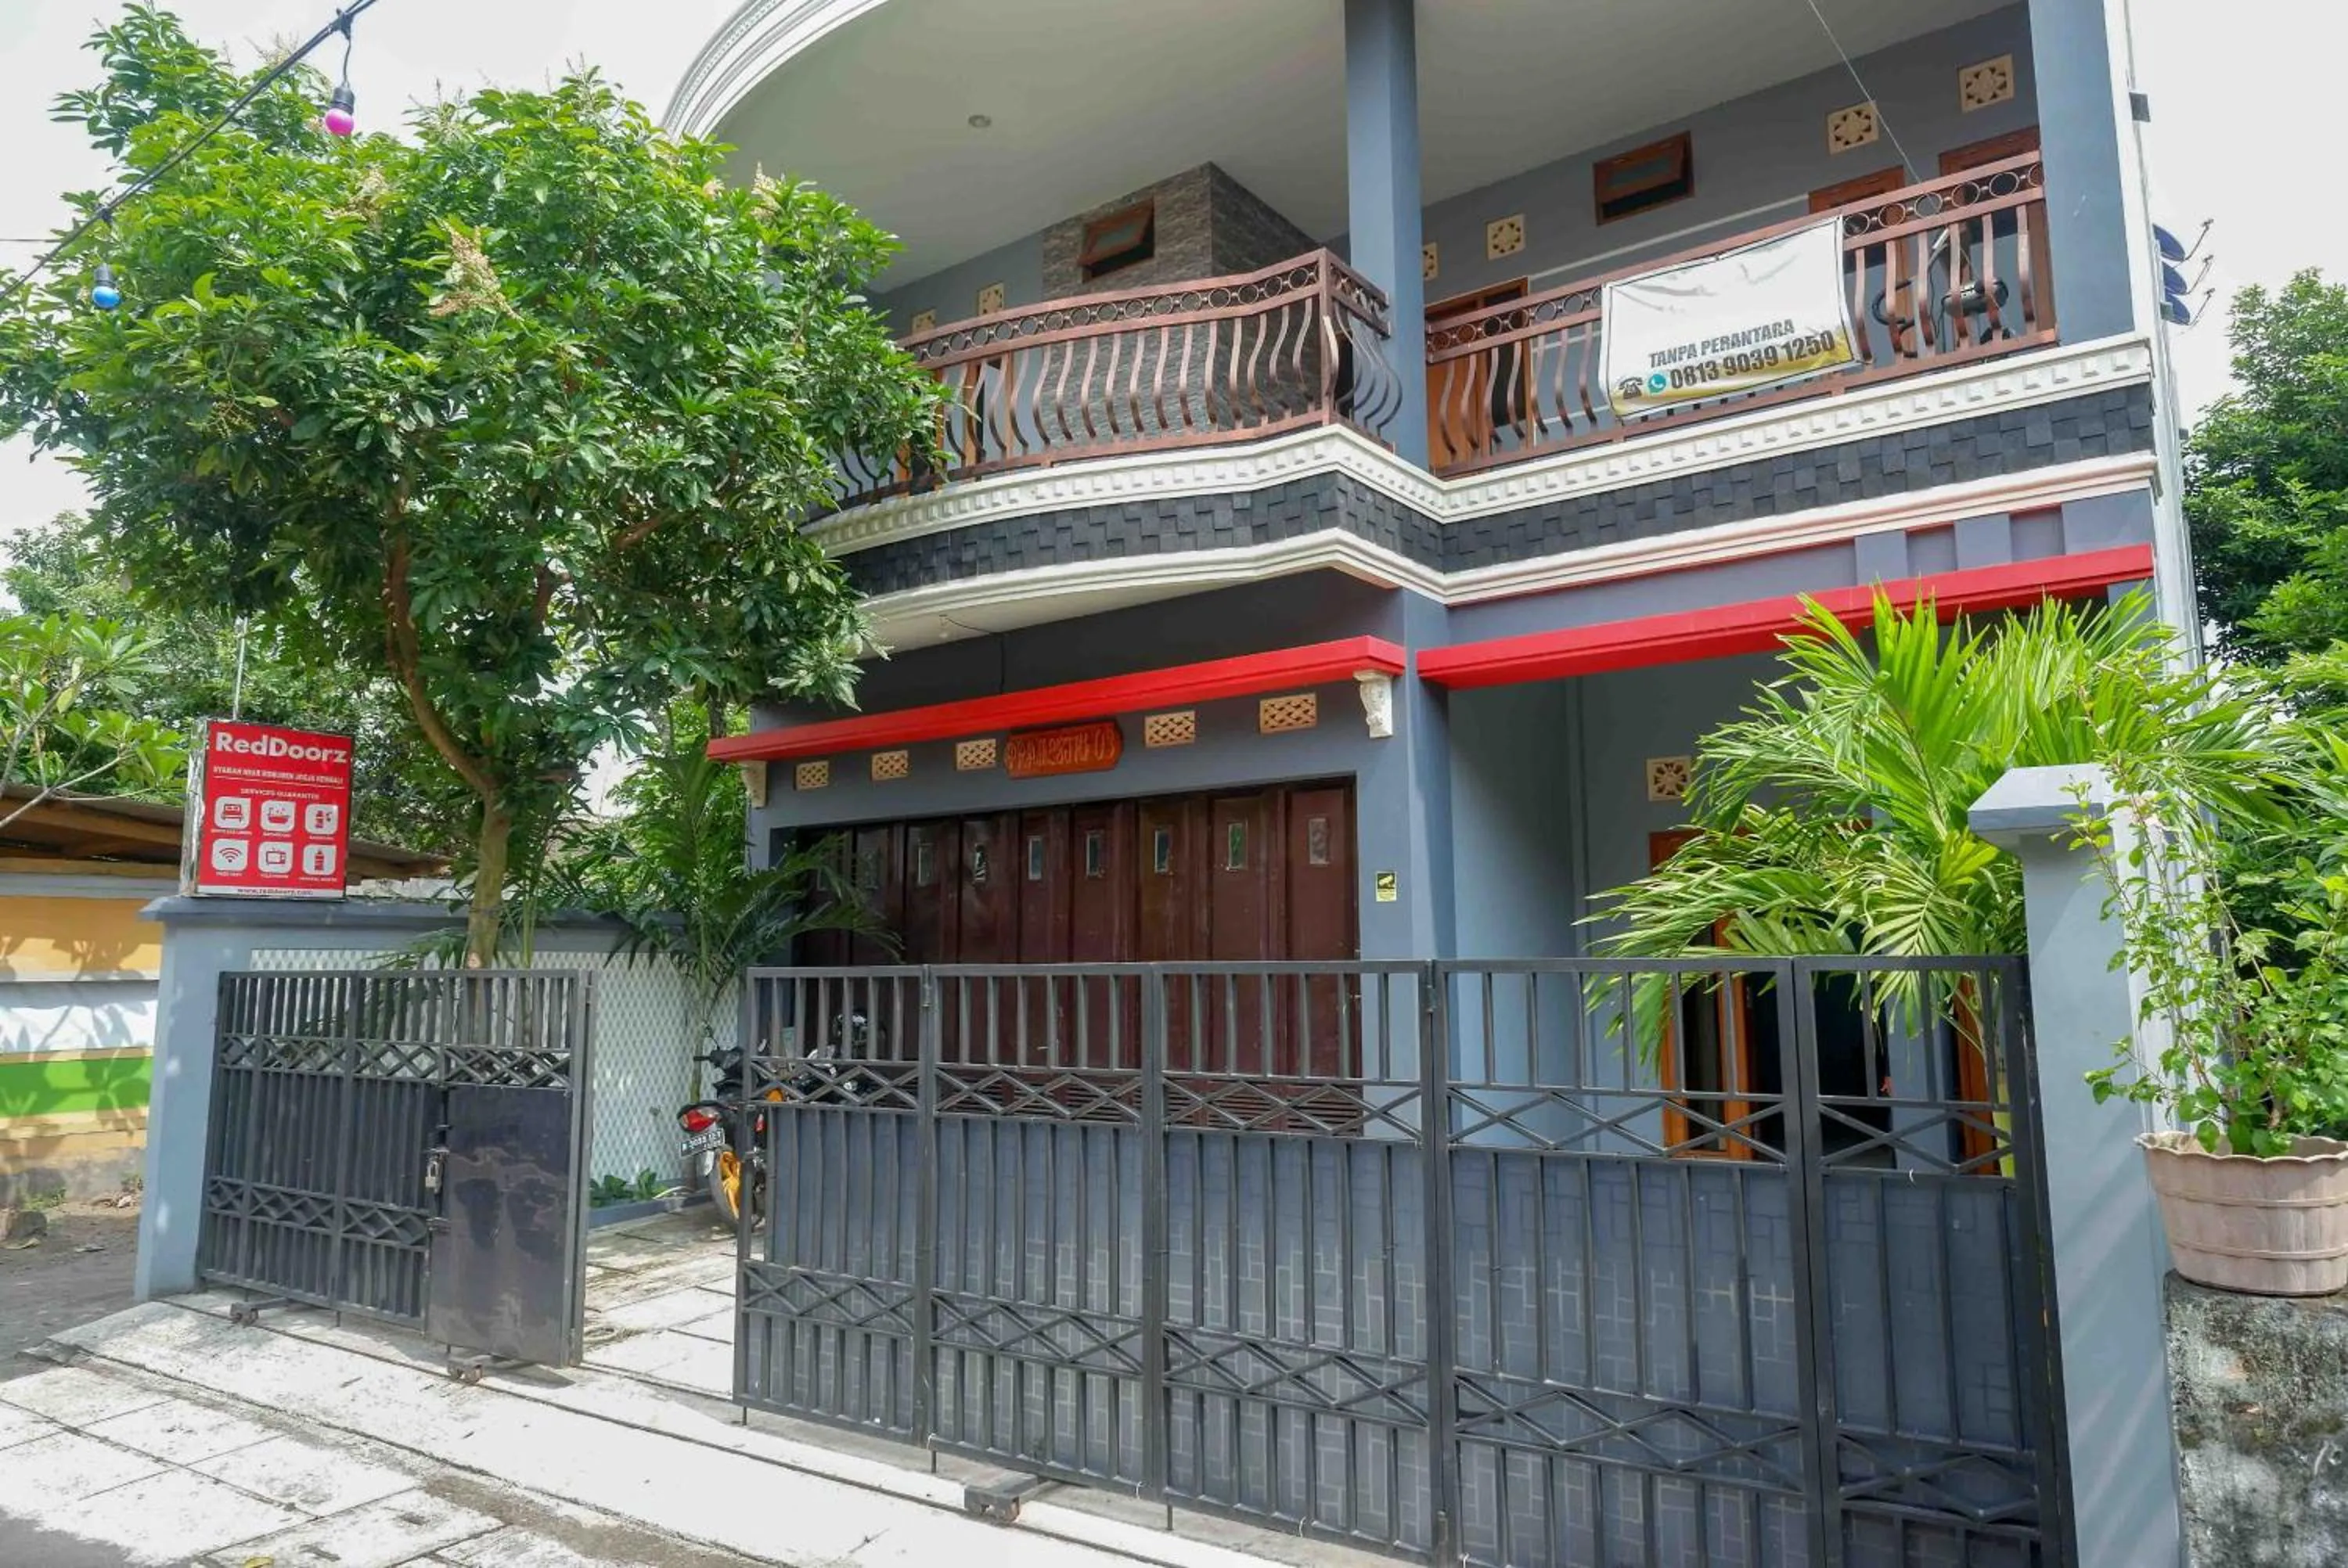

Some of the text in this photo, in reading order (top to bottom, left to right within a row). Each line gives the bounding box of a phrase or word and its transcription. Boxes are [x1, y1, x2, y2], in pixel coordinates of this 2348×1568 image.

[1649, 318, 1795, 369] TANPA PERANTARA
[1670, 329, 1835, 390] 0813 9039 1250
[215, 732, 348, 764] RedDoorz
